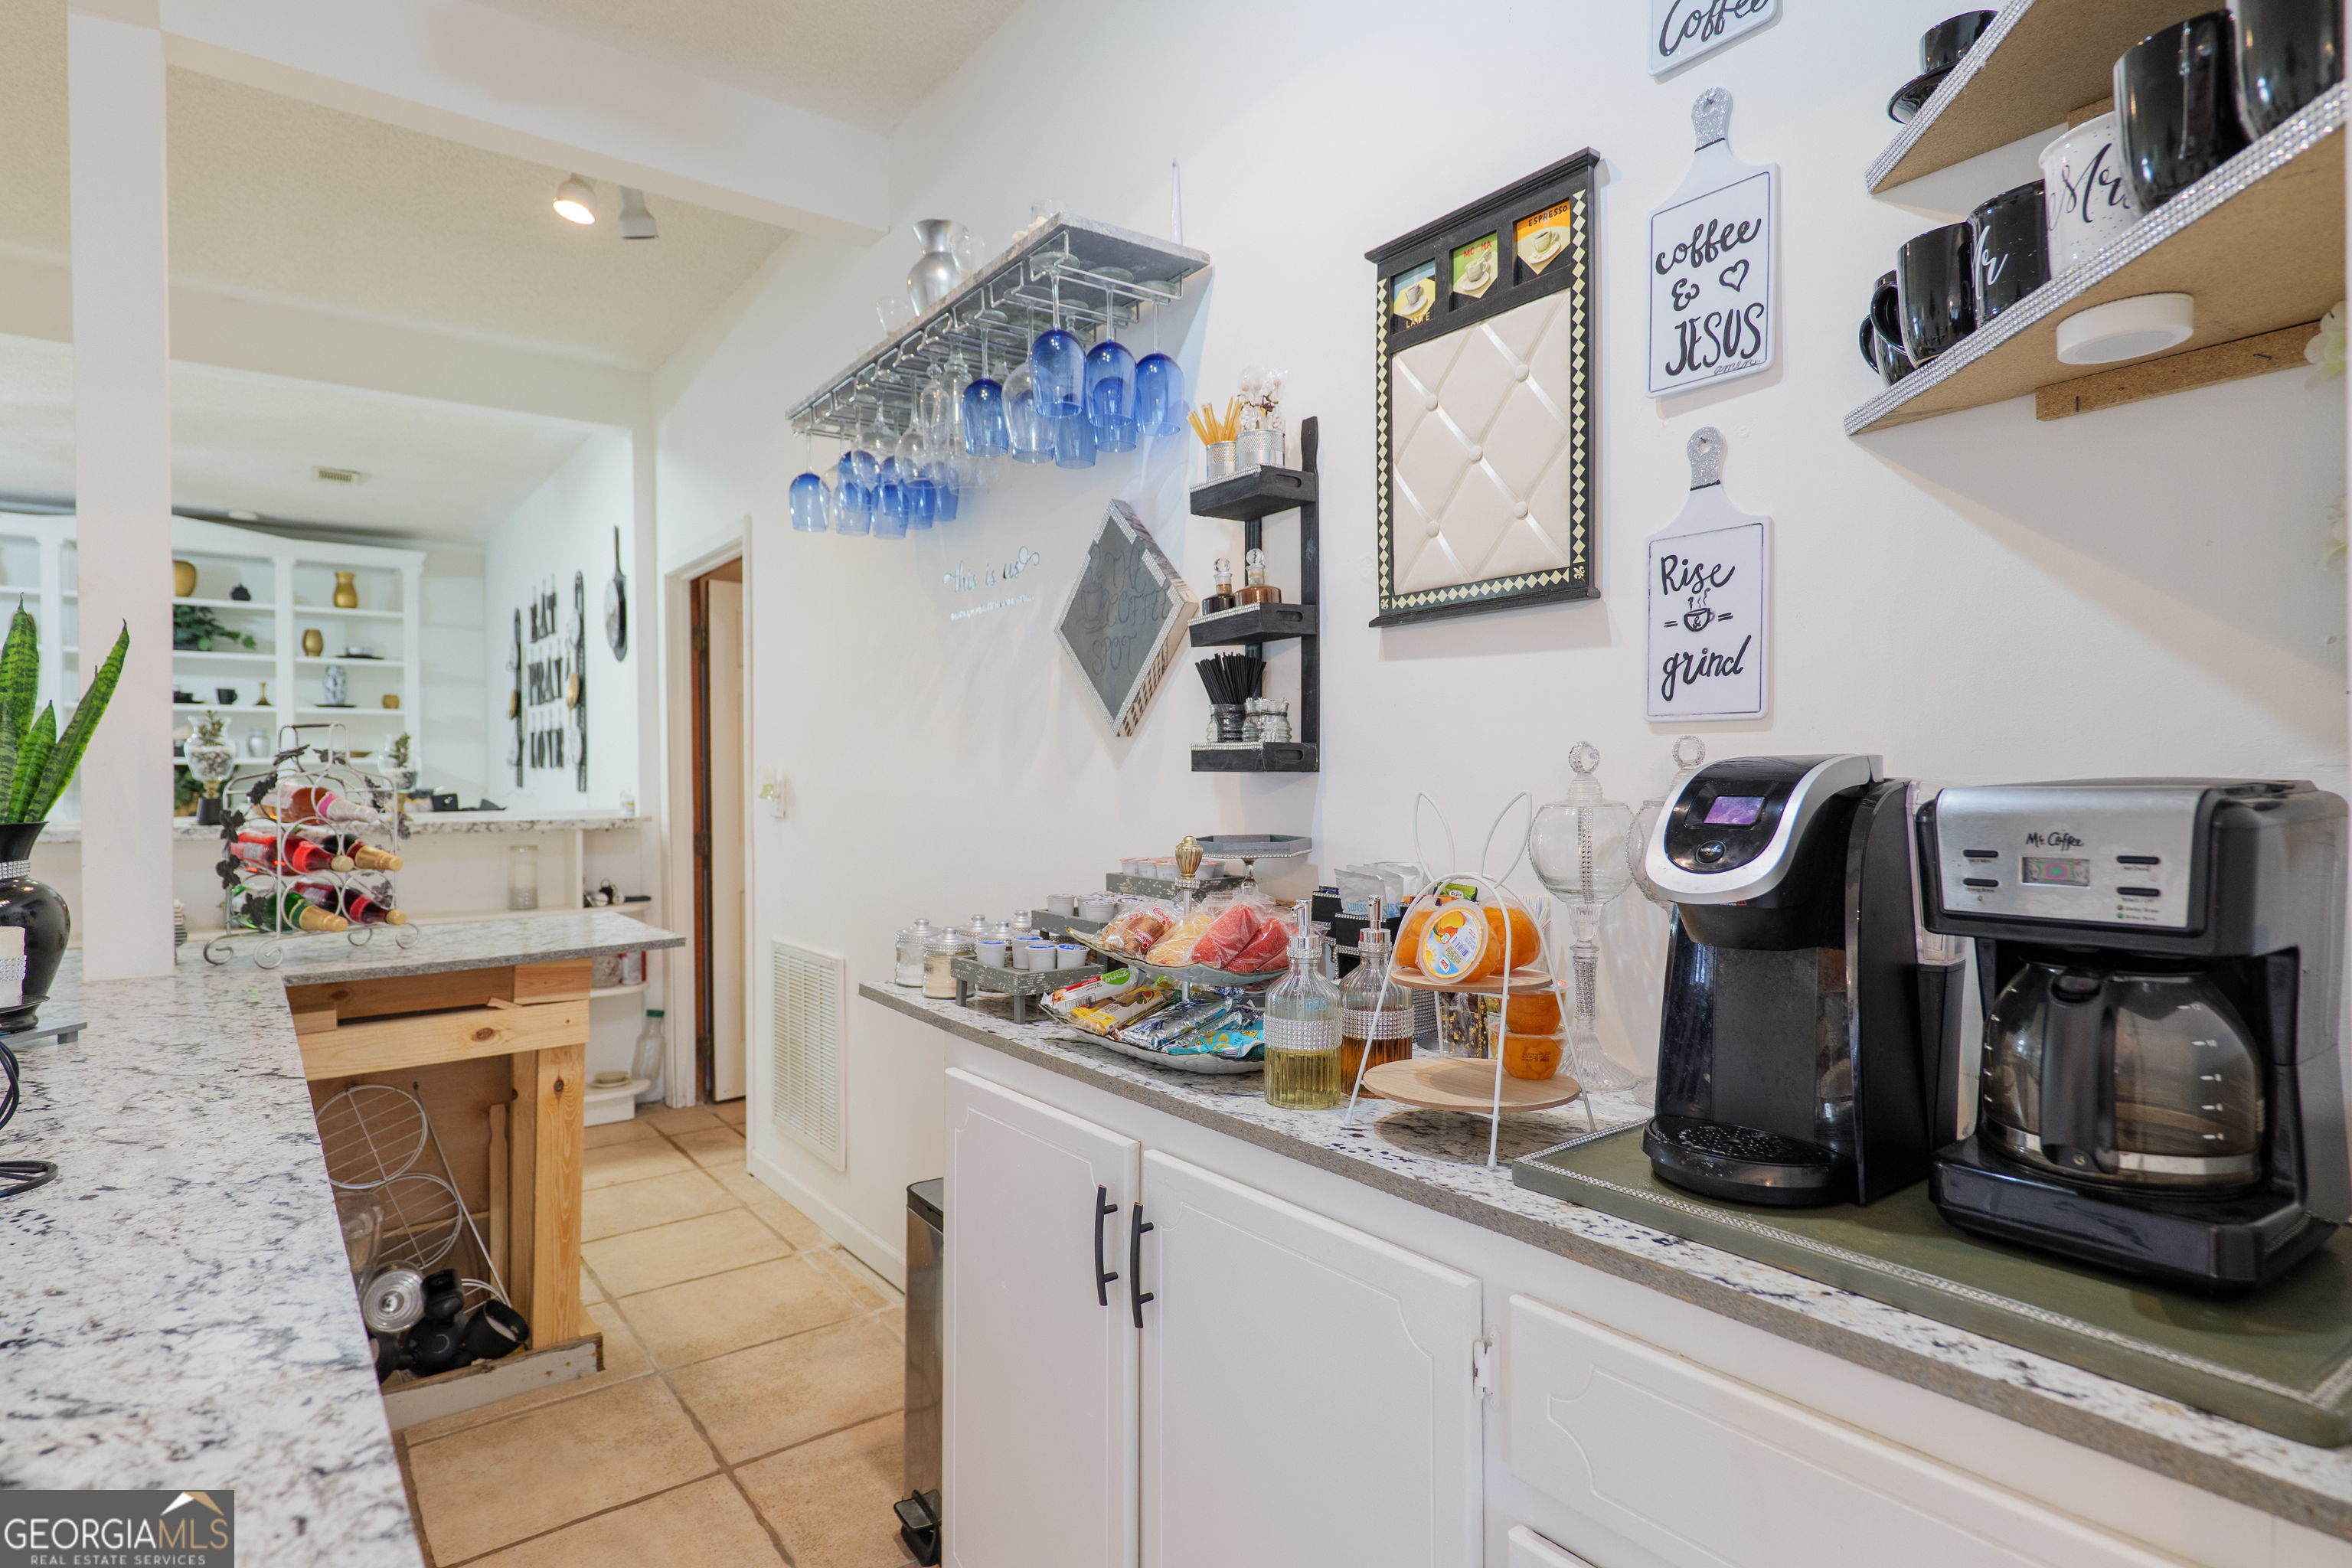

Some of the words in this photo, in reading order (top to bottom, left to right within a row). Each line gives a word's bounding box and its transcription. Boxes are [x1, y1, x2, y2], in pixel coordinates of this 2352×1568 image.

[1528, 204, 1568, 227] ESPRESSO
[1463, 240, 1492, 259] MOCHA
[1655, 218, 1762, 275] coffee
[1406, 312, 1431, 329] LATTE
[1665, 302, 1764, 376] JESUS
[943, 560, 978, 594] this
[985, 563, 997, 586] is
[1003, 546, 1040, 580] us
[1105, 543, 1147, 593] THE
[1661, 554, 1736, 596] Rise
[530, 591, 557, 643] EAT
[1106, 586, 1170, 628] COFFEE
[1092, 630, 1138, 676] SPOT
[1661, 635, 1752, 701] grind
[528, 656, 564, 706] PRAY
[2047, 831, 2085, 851] Coffee
[1345, 901, 1367, 913] SWISS
